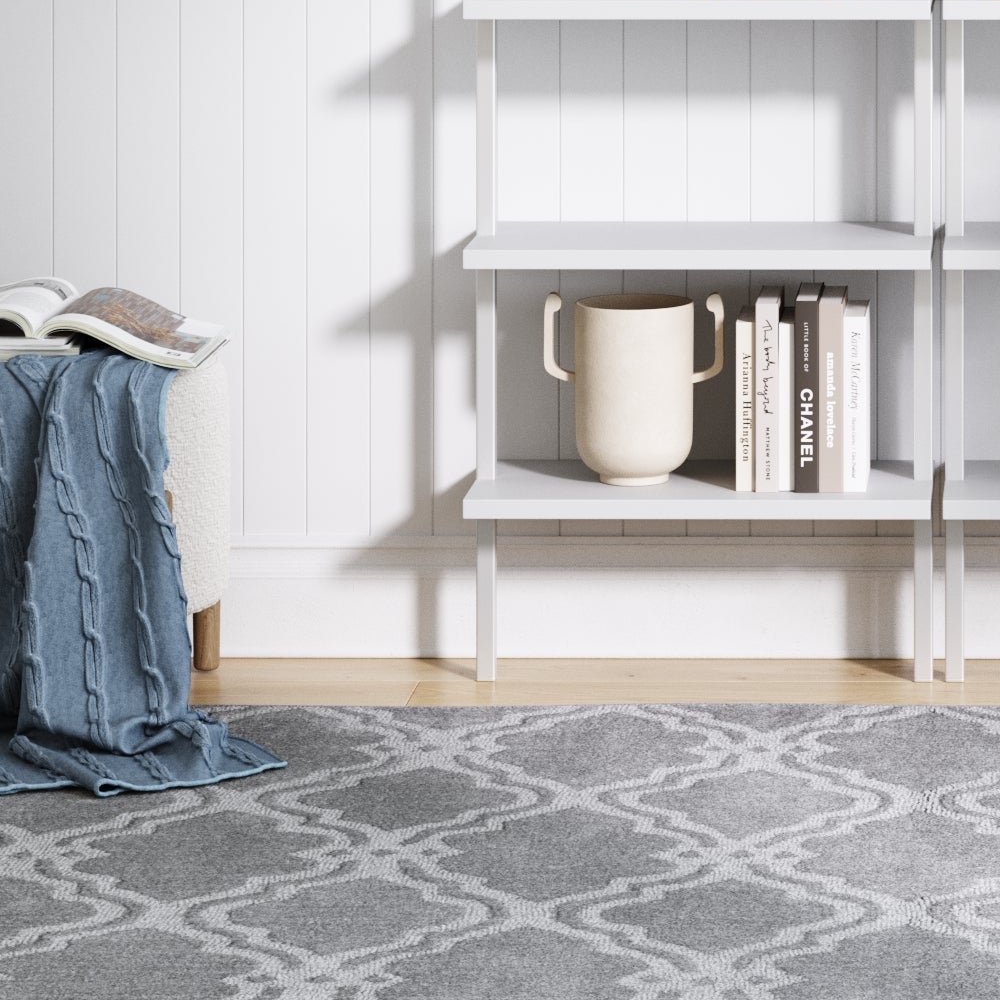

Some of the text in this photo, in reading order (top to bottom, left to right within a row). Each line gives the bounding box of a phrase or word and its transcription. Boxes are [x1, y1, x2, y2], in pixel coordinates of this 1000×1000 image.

[803, 363, 809, 372] OF
[849, 331, 861, 358] Karen
[739, 353, 752, 462] Arianna Huffington
[826, 352, 836, 448] amanda lovelace
[847, 362, 861, 410] McCartney
[799, 388, 814, 468] CHANEL
